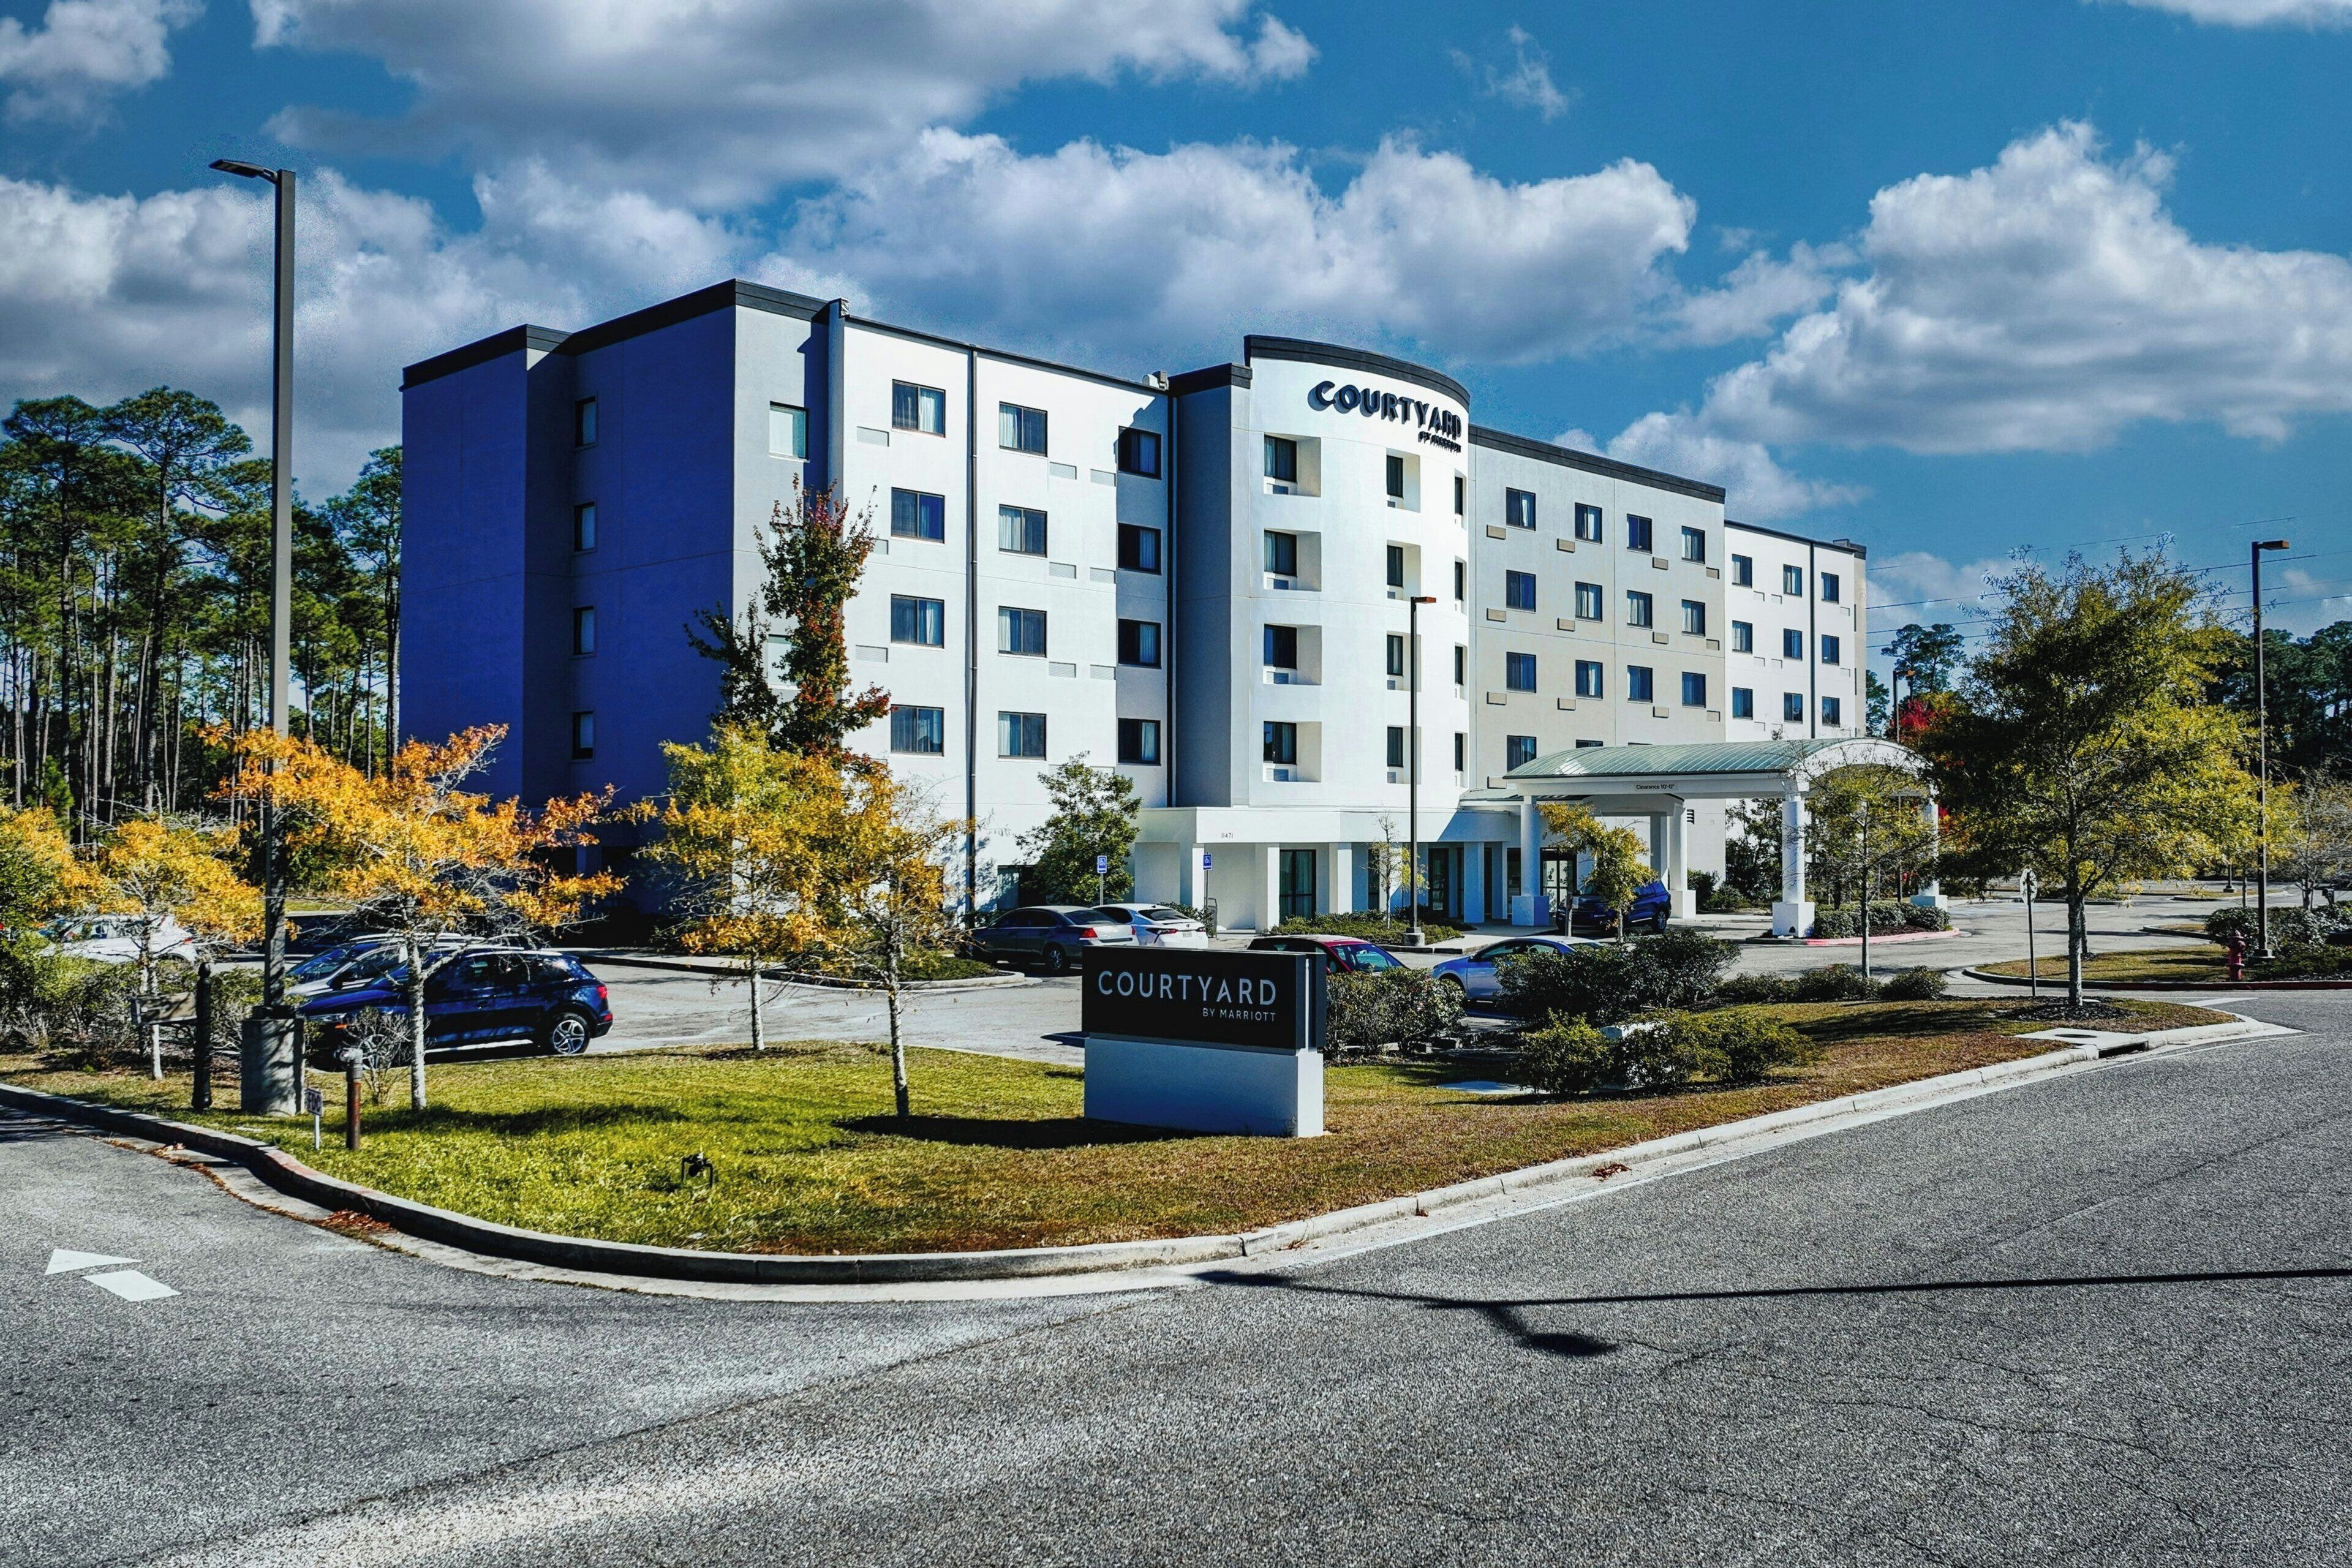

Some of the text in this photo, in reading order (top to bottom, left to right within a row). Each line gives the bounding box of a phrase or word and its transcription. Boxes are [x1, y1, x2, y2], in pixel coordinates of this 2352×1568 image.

[1308, 381, 1461, 440] COURTYARD
[1098, 970, 1276, 1006] COURTYARD
[1203, 1008, 1276, 1022] BY MARRIOTT
[307, 1091, 322, 1112] FDC
